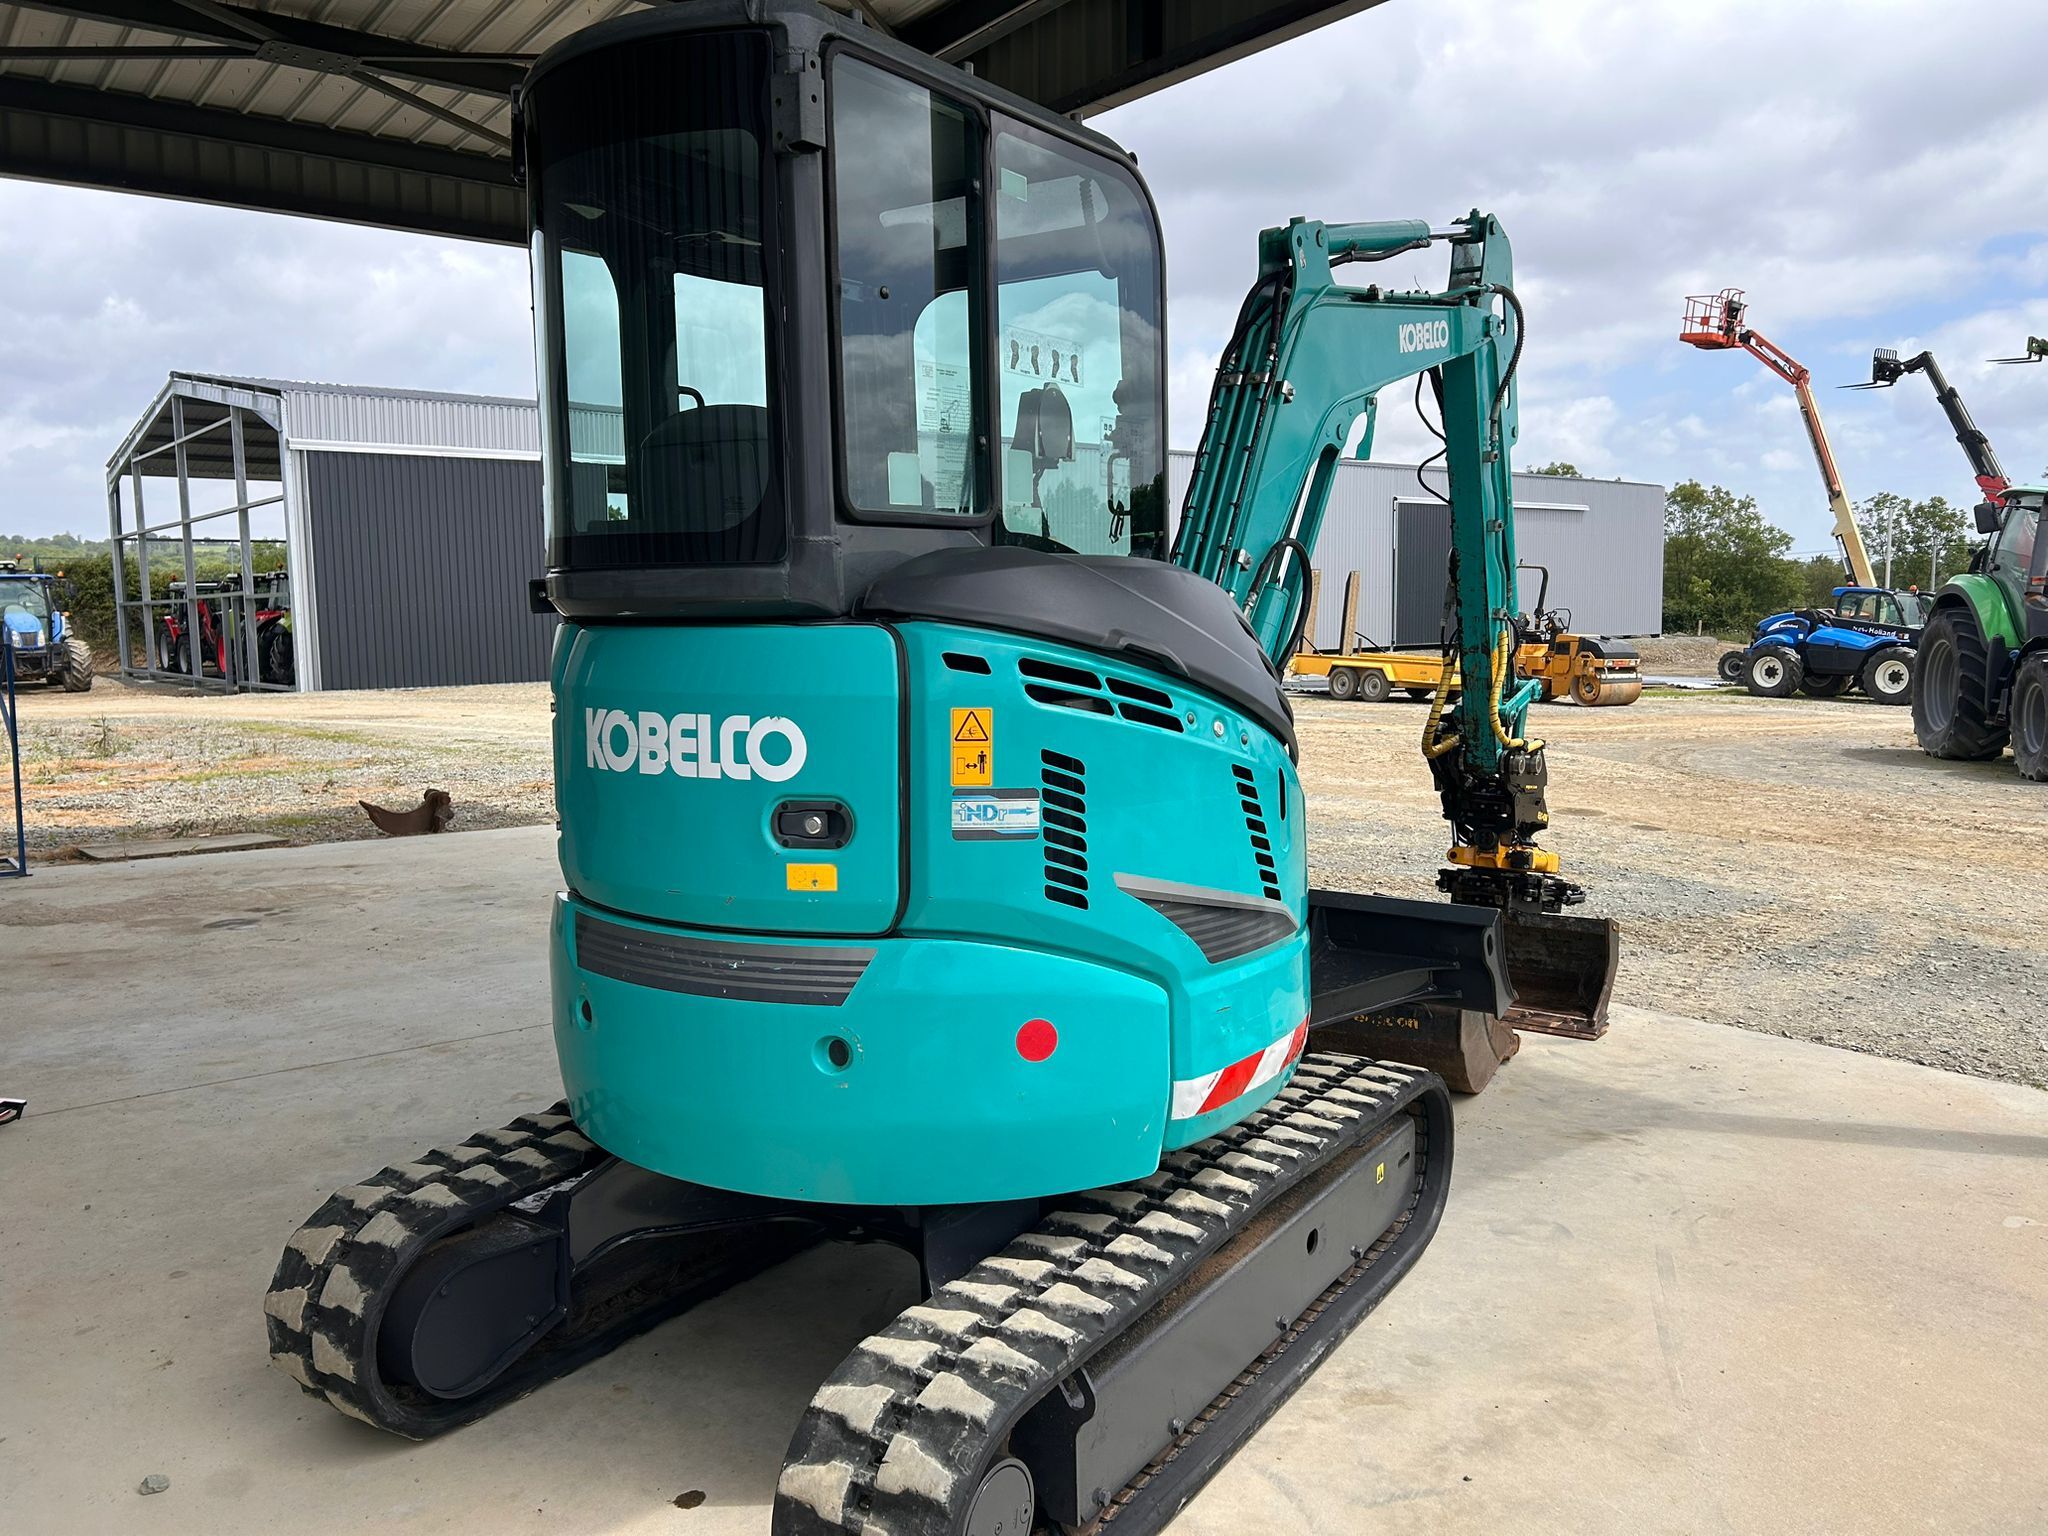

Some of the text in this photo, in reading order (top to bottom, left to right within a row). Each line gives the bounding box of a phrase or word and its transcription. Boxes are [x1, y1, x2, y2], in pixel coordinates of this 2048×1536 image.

[1399, 320, 1449, 353] KOBELCO
[1868, 627, 1897, 637] Holland
[585, 707, 808, 783] KOBELCO
